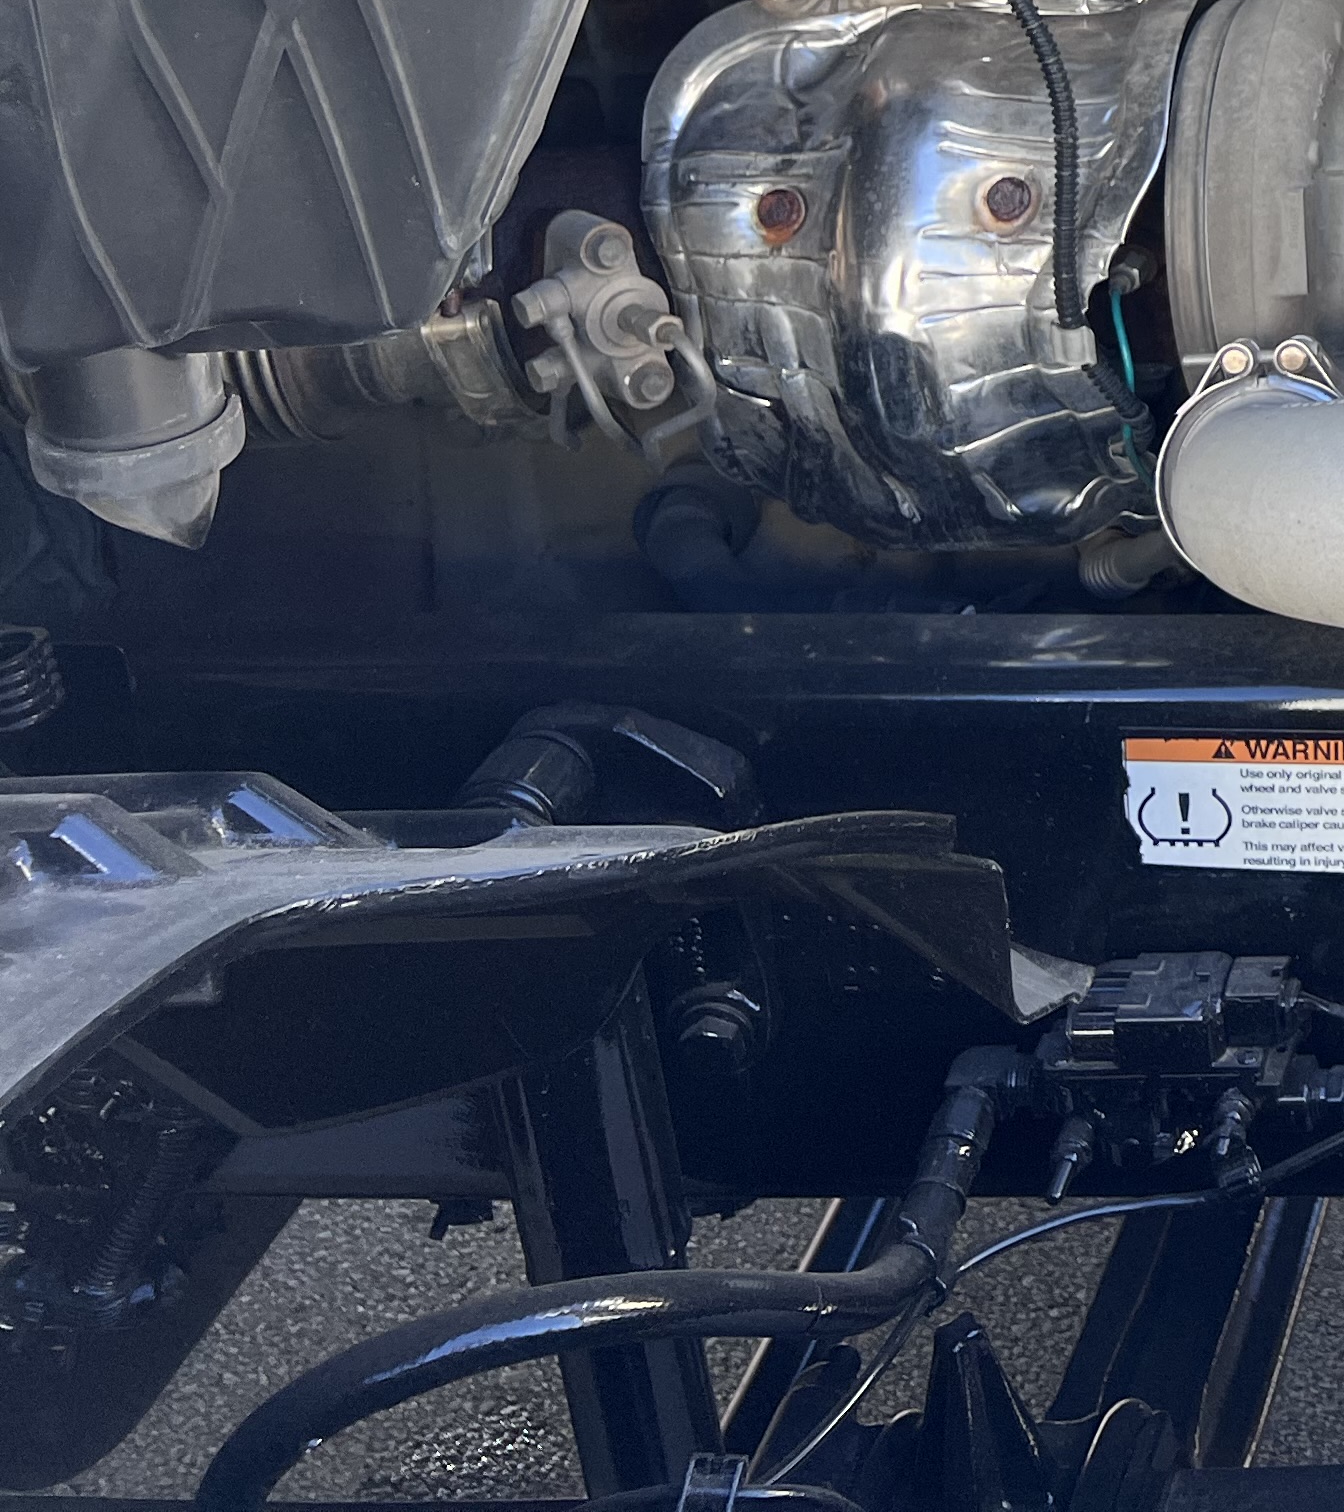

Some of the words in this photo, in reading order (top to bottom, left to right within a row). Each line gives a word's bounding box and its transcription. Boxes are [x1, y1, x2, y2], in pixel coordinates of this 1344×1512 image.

[1239, 768, 1264, 779] Use
[1266, 769, 1293, 781] only
[1296, 769, 1342, 782] original
[1240, 784, 1275, 794] wheel
[1278, 785, 1302, 794] and
[1305, 785, 1338, 795] valve
[1241, 804, 1303, 816] Otherwise
[1305, 806, 1338, 816] valve
[1241, 818, 1276, 829] brake
[1278, 819, 1319, 832] caliper
[1243, 841, 1268, 852] This
[1271, 843, 1297, 854] may
[1300, 842, 1335, 853] affect
[1243, 856, 1296, 869] resulting
[1299, 857, 1311, 867] in
